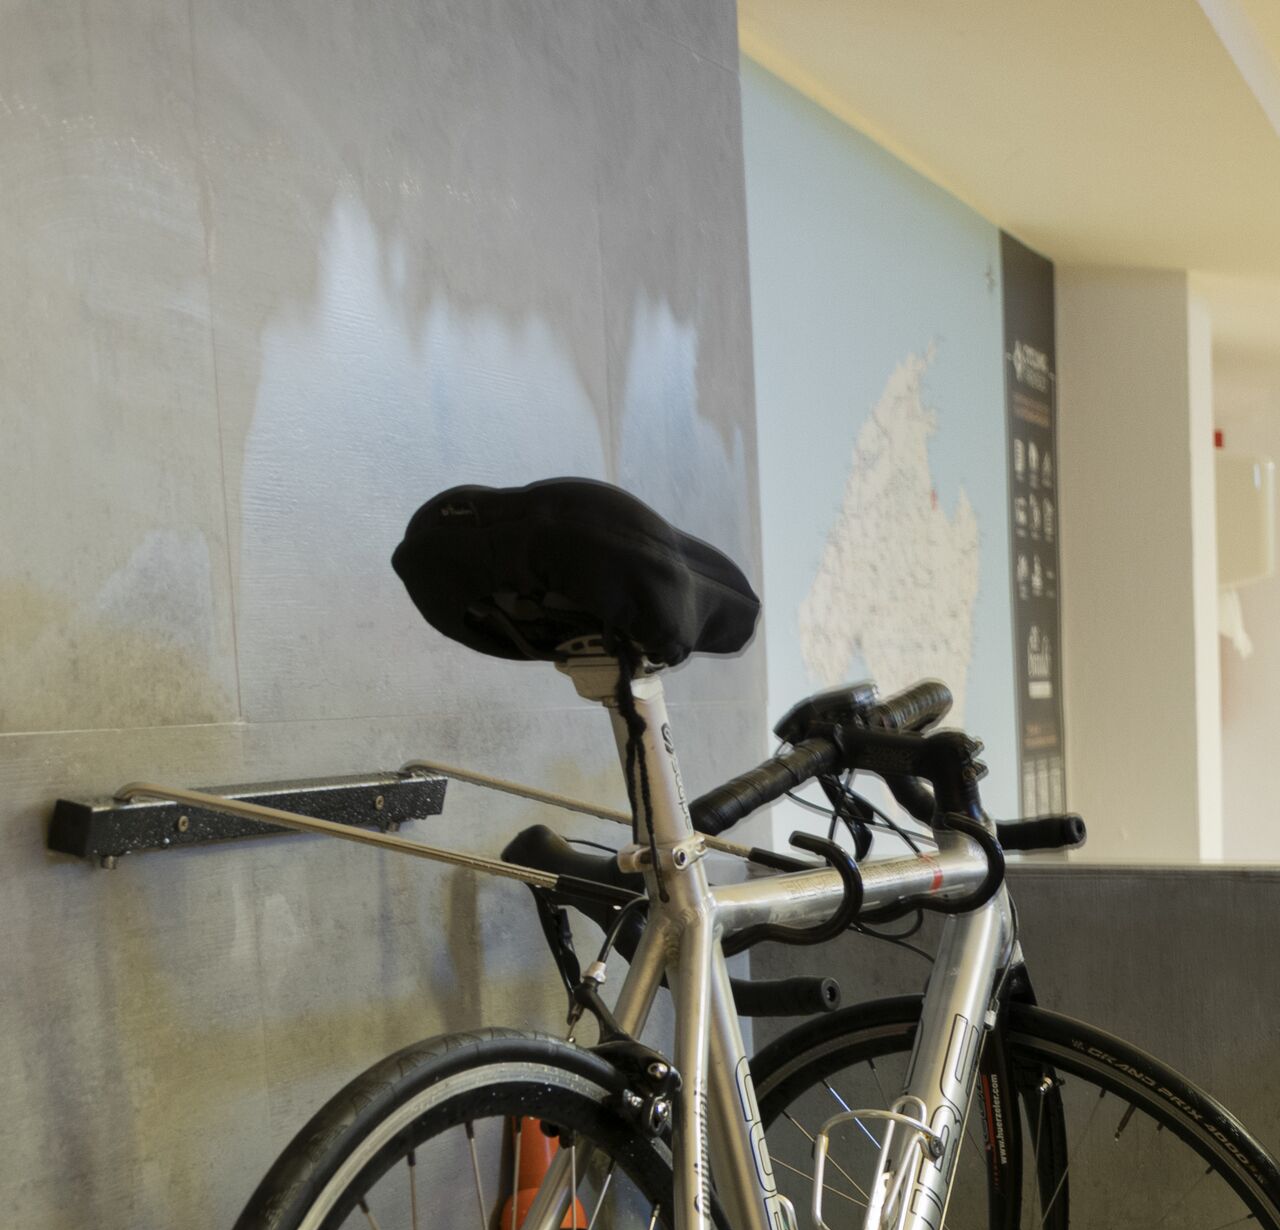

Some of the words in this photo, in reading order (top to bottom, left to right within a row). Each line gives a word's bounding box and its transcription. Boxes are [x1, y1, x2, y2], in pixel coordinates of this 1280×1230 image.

[991, 1073, 1008, 1165] www.huerzeler.com
[1087, 1047, 1156, 1088] GRAND
[1157, 1086, 1204, 1121] PRIX
[1204, 1121, 1249, 1165] 4000
